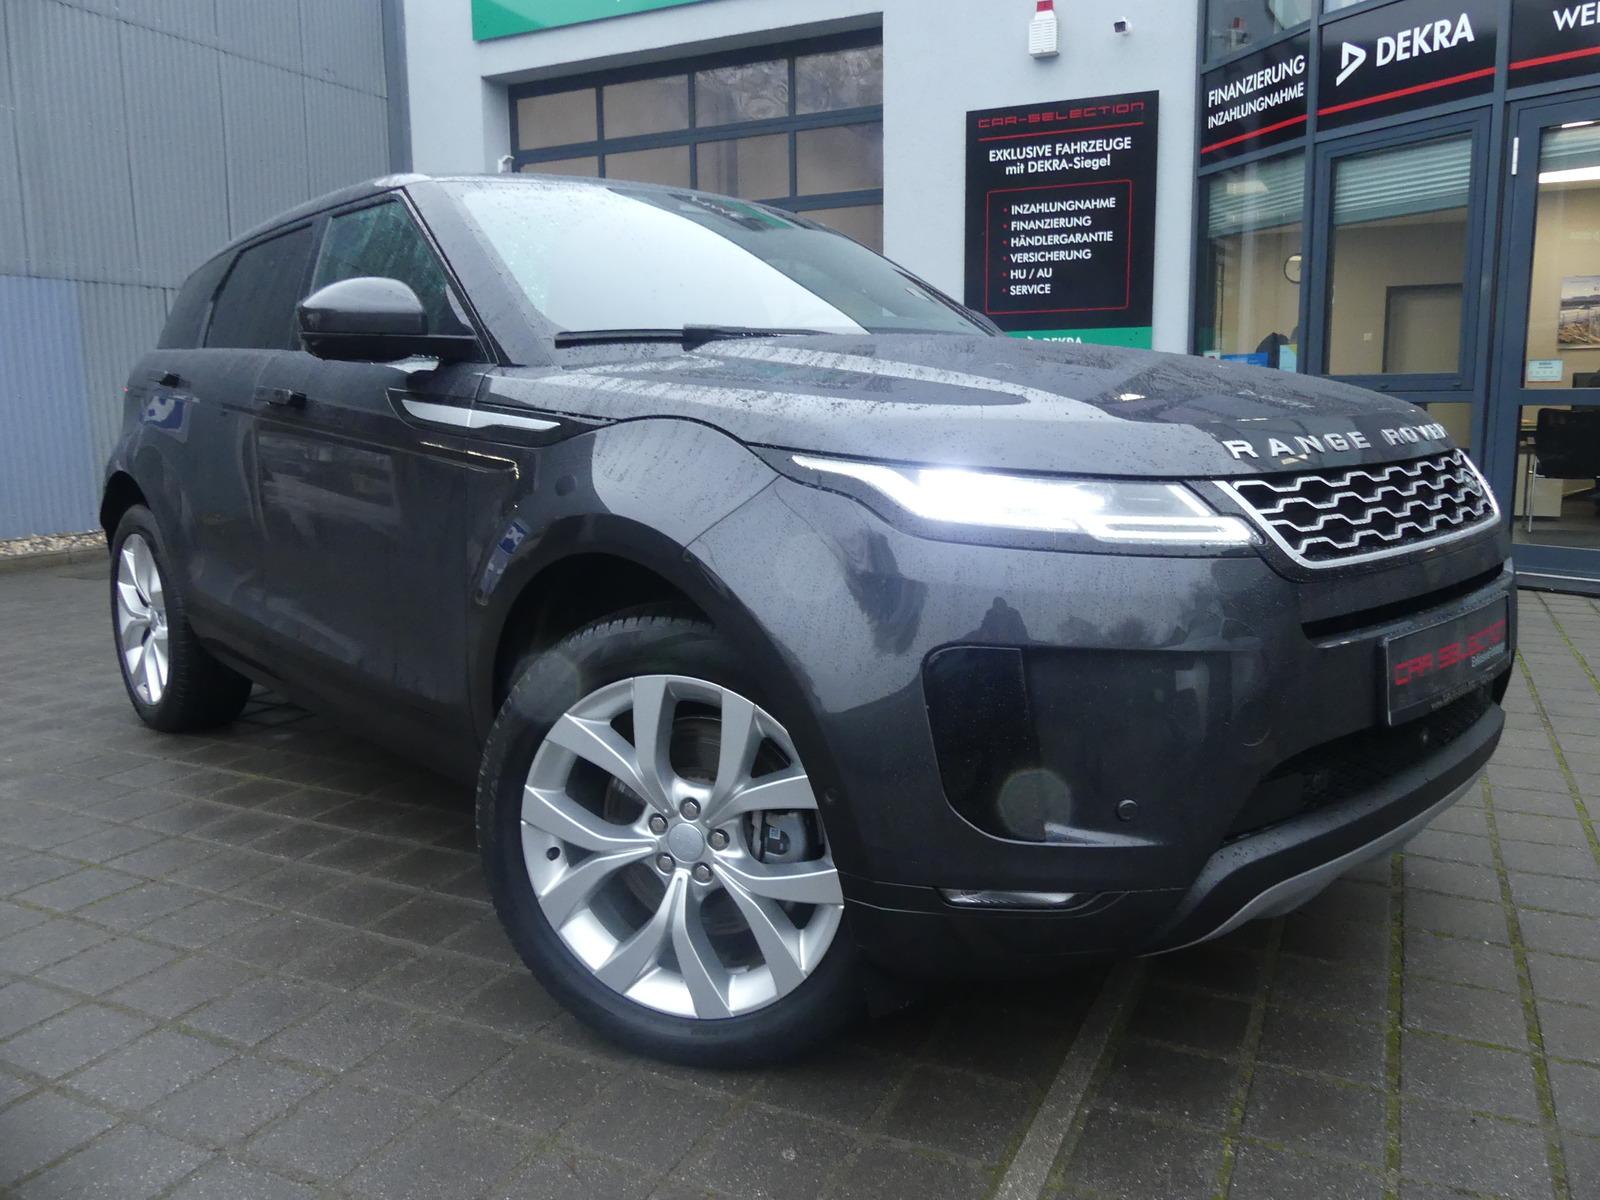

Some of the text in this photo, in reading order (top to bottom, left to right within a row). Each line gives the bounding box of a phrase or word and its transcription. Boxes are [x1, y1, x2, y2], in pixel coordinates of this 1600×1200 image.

[1376, 12, 1475, 67] DEKRA
[1208, 54, 1306, 108] FINANZIERUNG
[1207, 81, 1304, 129] INZAHLUNGNAHME
[989, 136, 1132, 162] EXKLUSIVE FAHRZEUGE
[1005, 154, 1111, 175] mit DEKRA-Siegel
[1011, 197, 1116, 215] INZAHLUNGNAHME
[1011, 216, 1092, 231] FINANZIERUNG
[1010, 231, 1113, 247] HÄNDLERGARANTIE
[1010, 249, 1092, 263] VERSICHERUNG
[1010, 267, 1053, 280] HU / AU
[1009, 284, 1051, 295] SERVICE
[1222, 431, 1371, 459] RANGE
